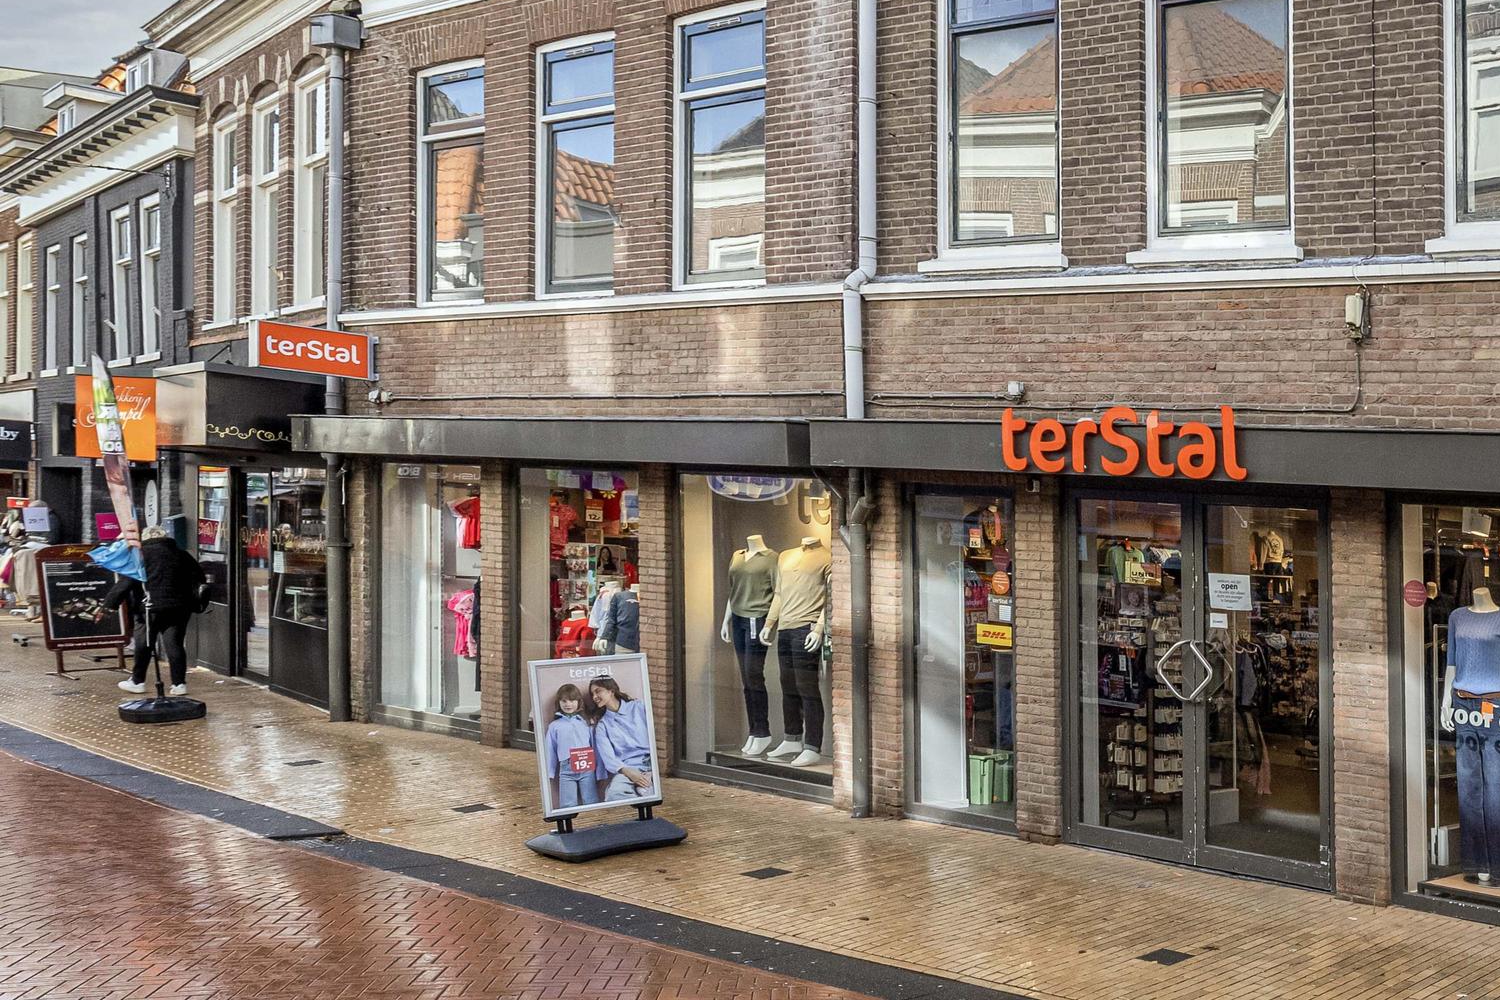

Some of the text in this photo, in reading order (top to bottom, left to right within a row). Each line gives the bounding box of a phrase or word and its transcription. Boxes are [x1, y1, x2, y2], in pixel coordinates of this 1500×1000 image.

[265, 335, 360, 365] terStal
[1001, 405, 1248, 481] terStal
[1220, 583, 1239, 591] open
[981, 630, 1008, 640] DHL
[569, 665, 614, 679] terStal
